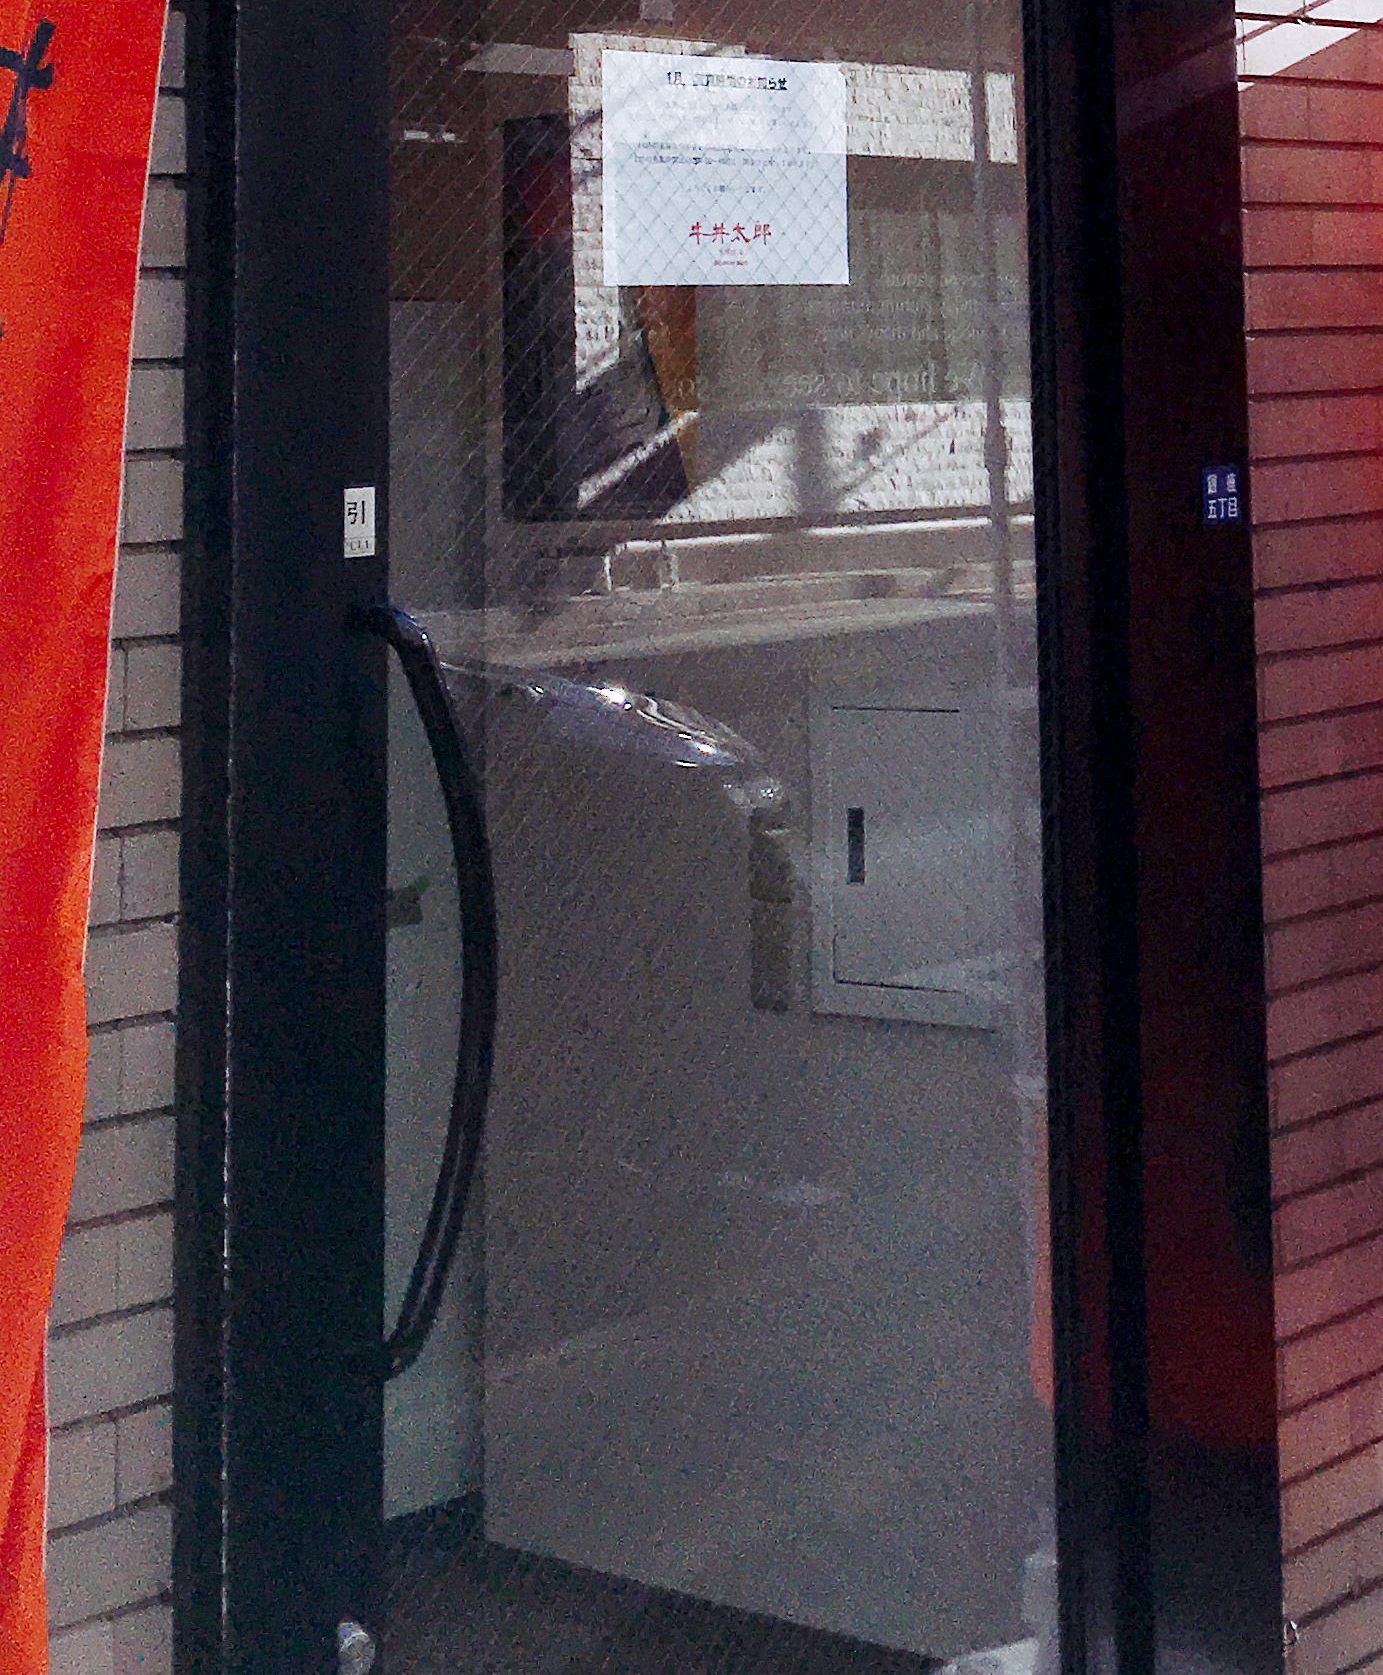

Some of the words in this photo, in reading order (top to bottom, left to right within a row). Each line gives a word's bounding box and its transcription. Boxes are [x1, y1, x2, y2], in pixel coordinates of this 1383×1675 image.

[346, 500, 366, 525] 引
[1207, 496, 1238, 519] 五丁目
